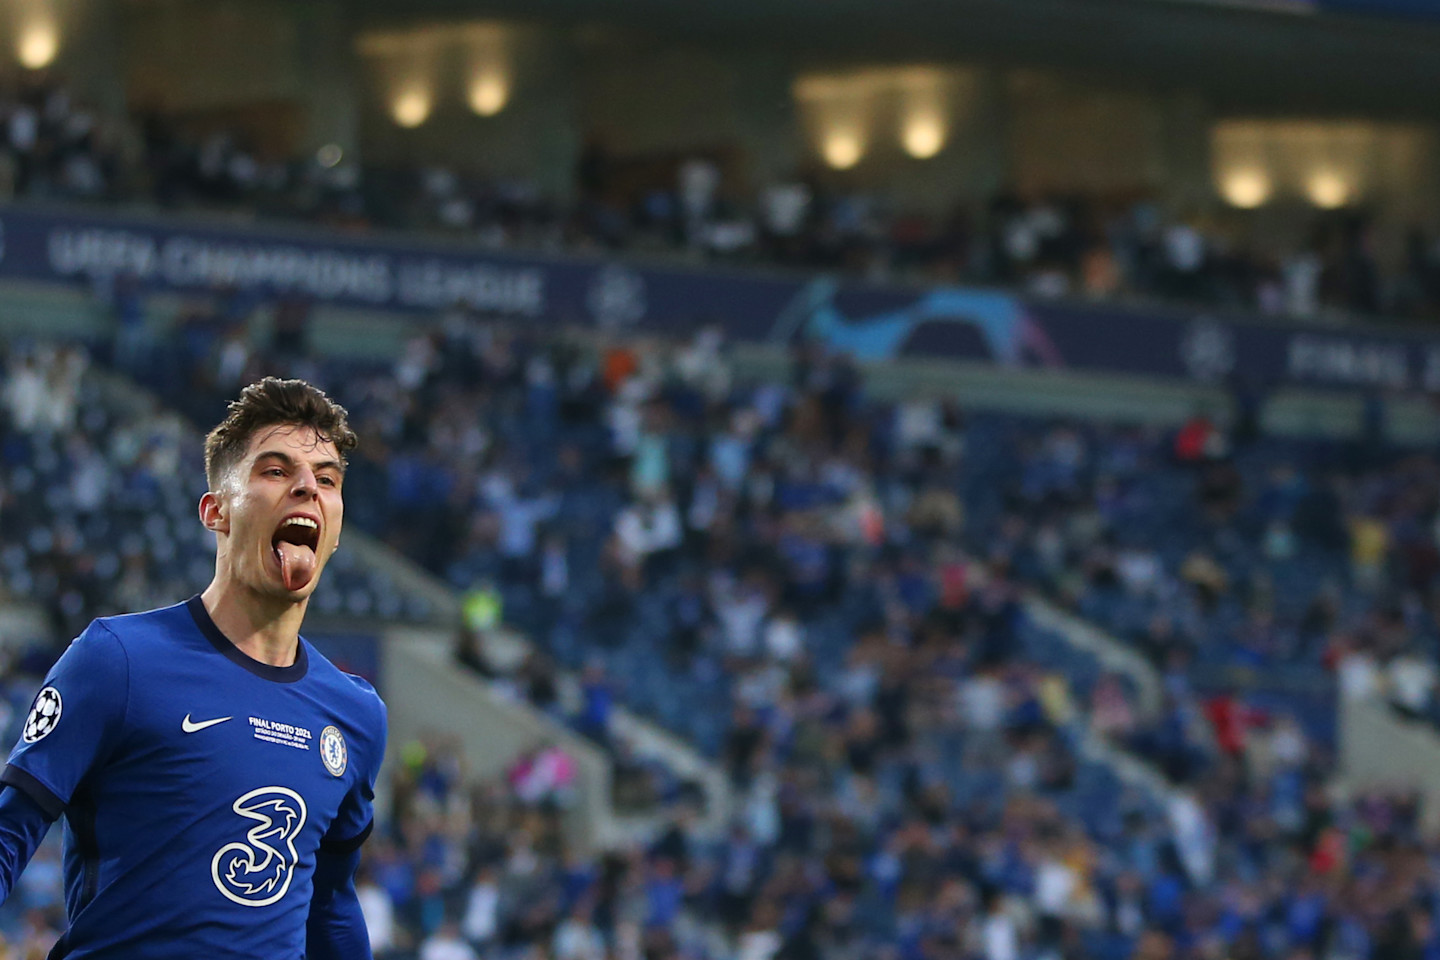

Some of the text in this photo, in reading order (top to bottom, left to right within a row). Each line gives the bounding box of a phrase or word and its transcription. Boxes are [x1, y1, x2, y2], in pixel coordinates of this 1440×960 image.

[48, 228, 156, 277] UEFA
[161, 235, 392, 303] CHAMPIONS
[248, 716, 271, 730] FINAL
[270, 721, 295, 735] PORTO
[294, 727, 312, 740] 2021
[211, 786, 308, 907] 3
